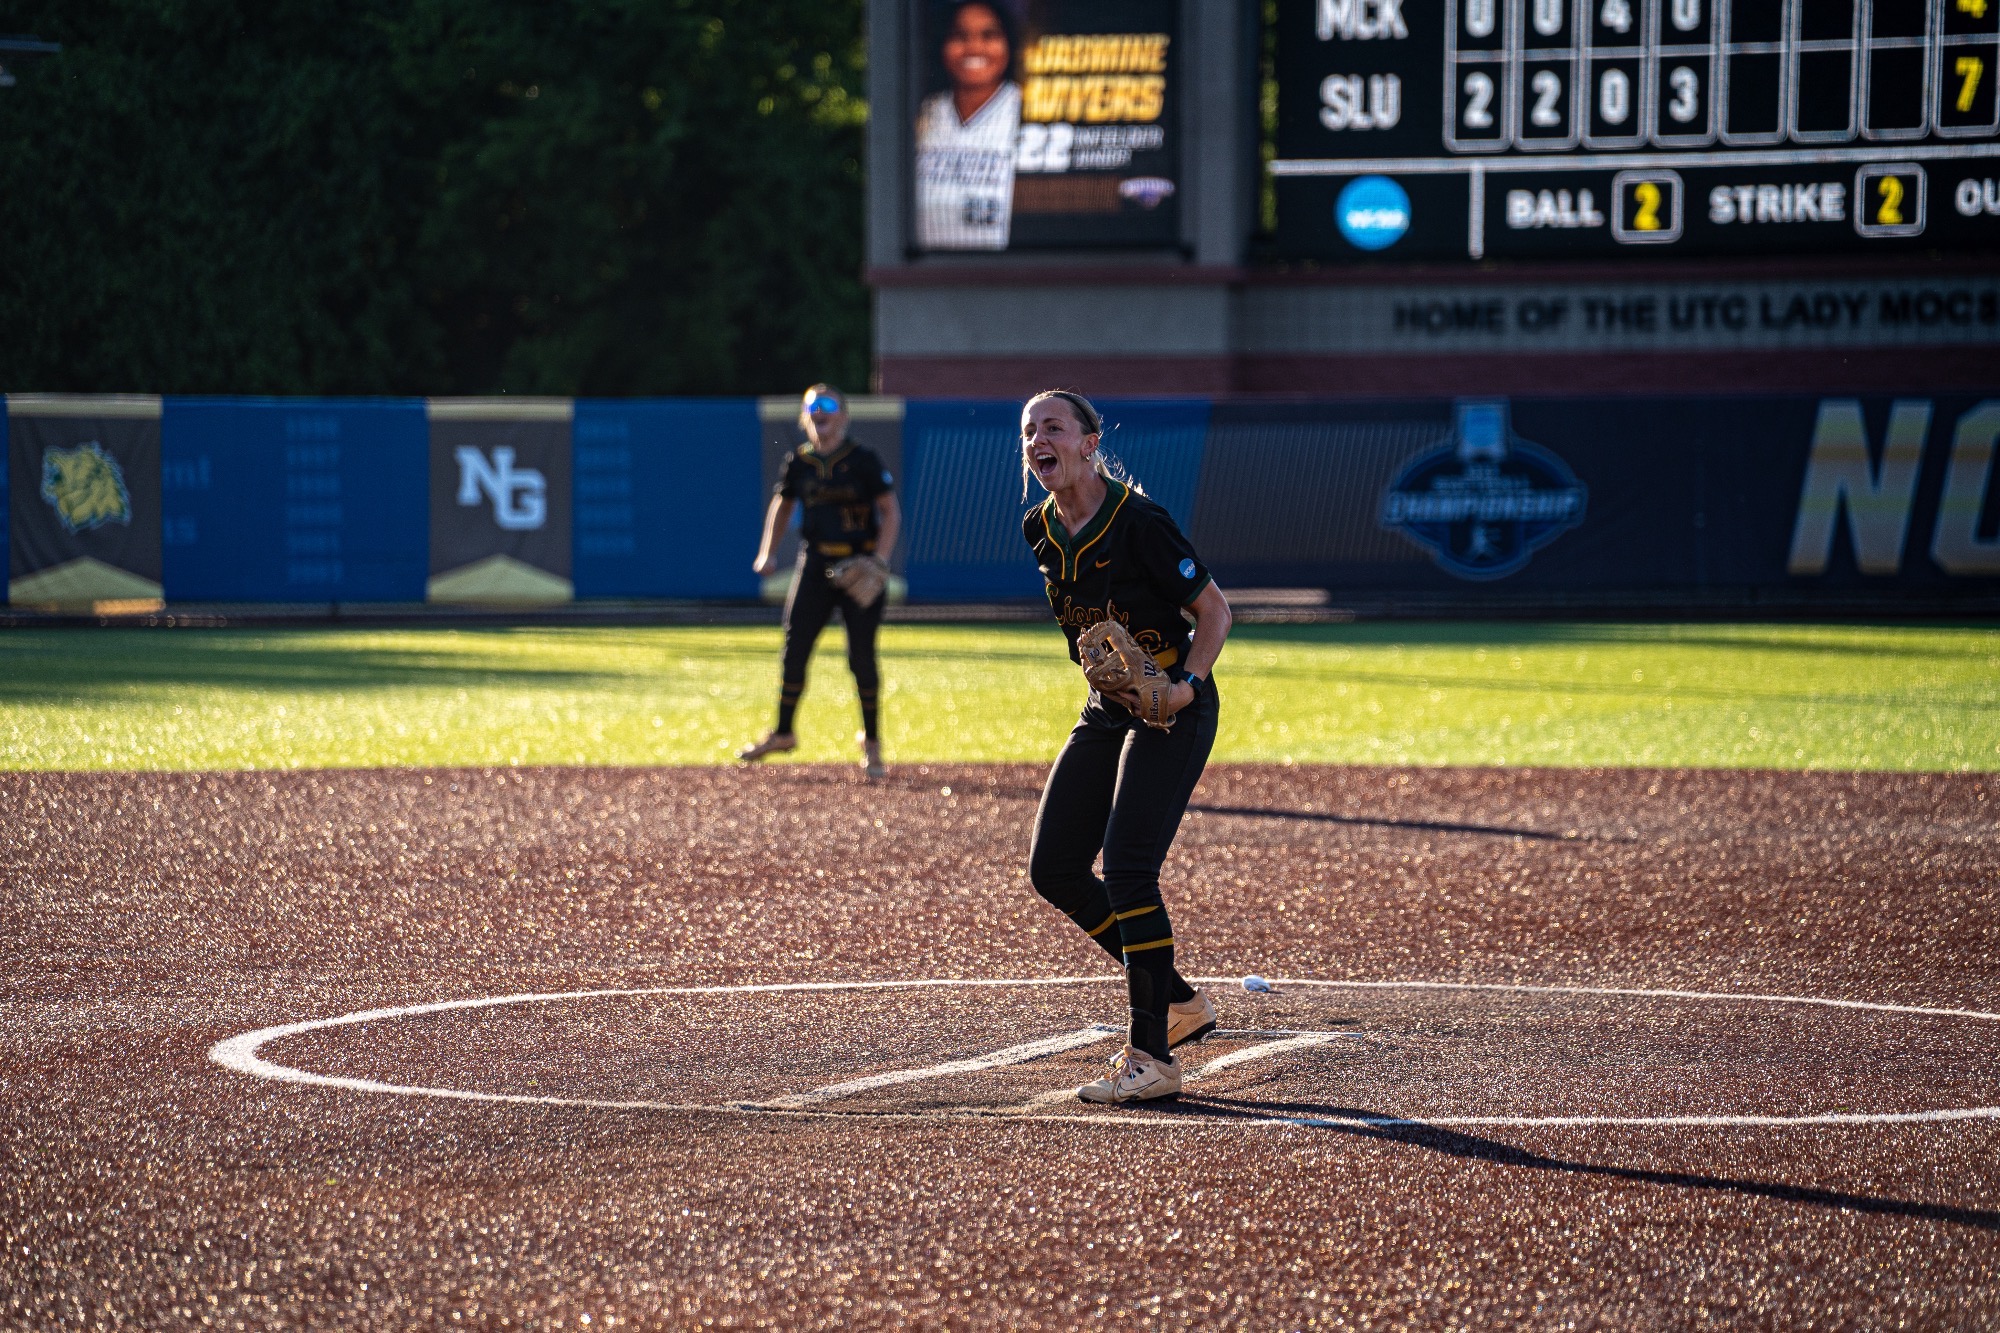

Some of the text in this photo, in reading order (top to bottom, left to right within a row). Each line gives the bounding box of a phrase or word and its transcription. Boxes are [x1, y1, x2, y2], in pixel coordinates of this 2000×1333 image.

[1319, 56, 1983, 131] SLU 2 2 0 3 7
[1016, 122, 1074, 172] 22
[1506, 181, 1663, 232] BALL 2
[1708, 175, 1904, 226] STRIKE 2
[1394, 298, 1504, 334] HOME
[1516, 297, 1569, 333] OF
[1582, 296, 1657, 332] THE
[1669, 294, 1748, 331] UTC
[1759, 291, 1867, 329] LADY
[454, 445, 547, 529] NG
